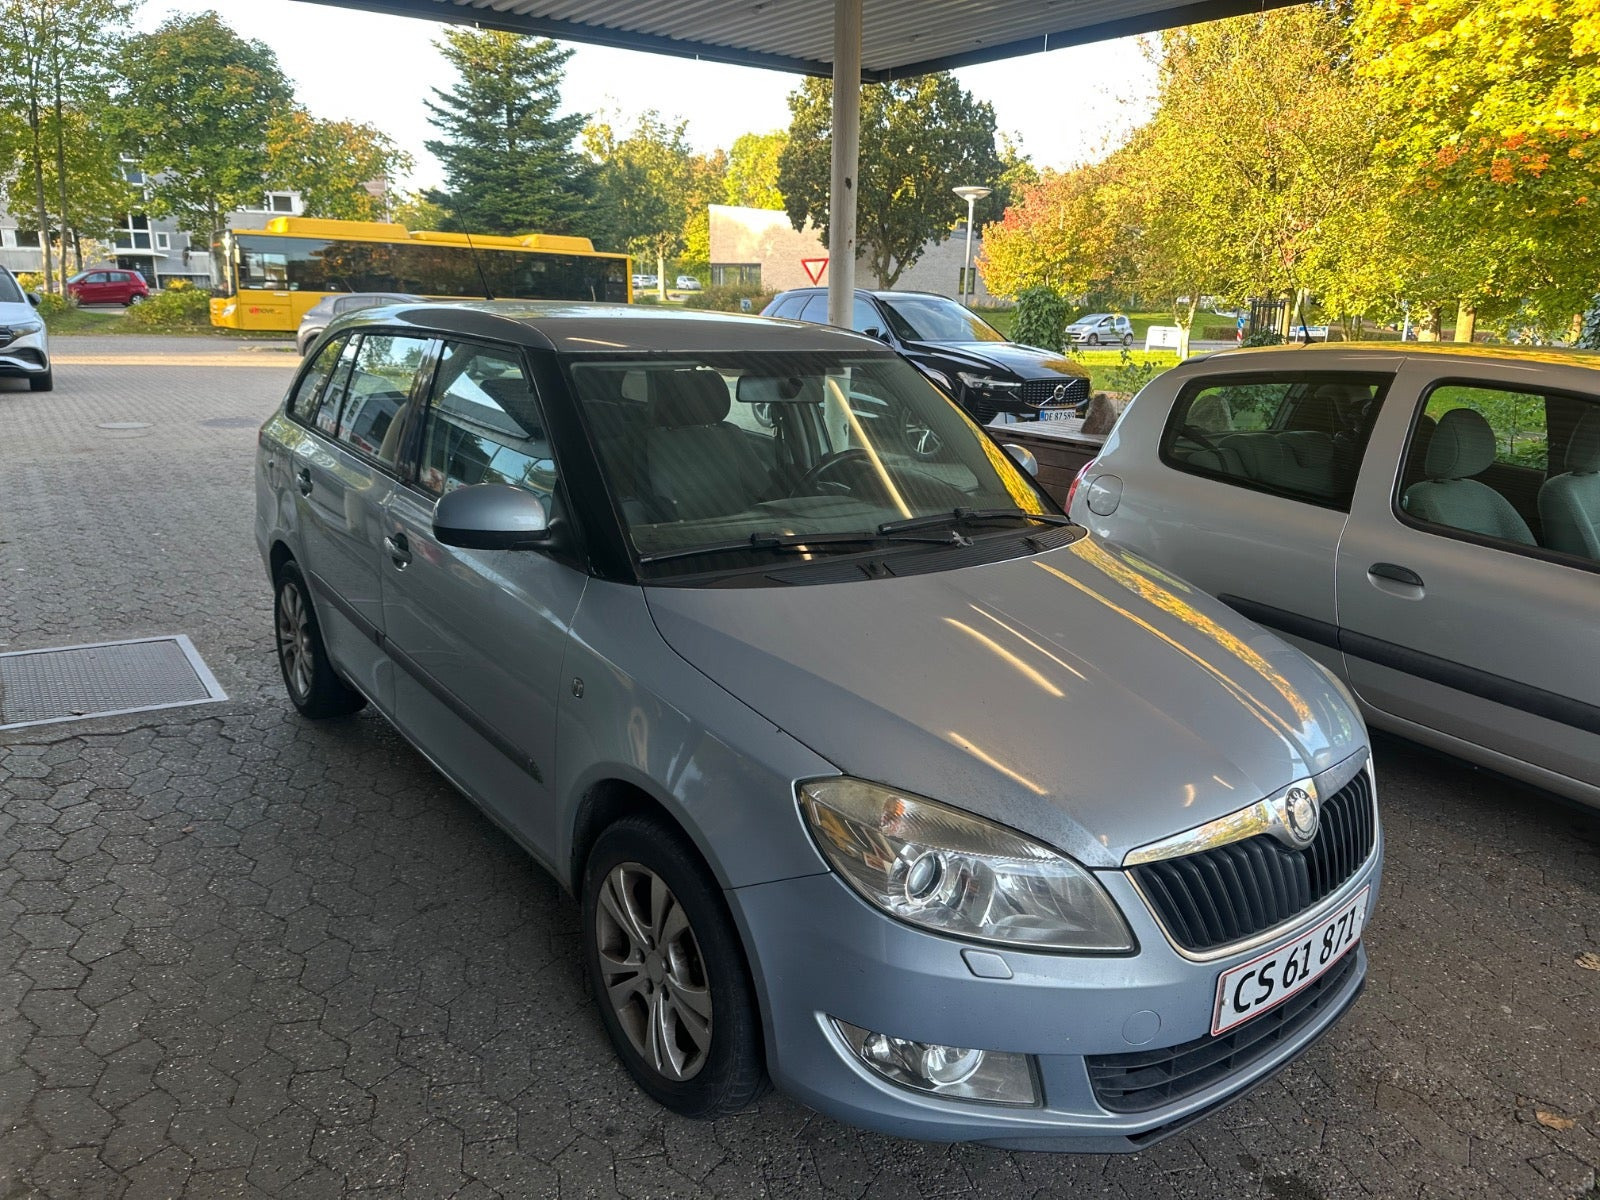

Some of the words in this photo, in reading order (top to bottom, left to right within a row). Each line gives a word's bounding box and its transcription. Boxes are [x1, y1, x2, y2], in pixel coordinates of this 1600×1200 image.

[1233, 960, 1276, 1013] CS
[1282, 940, 1312, 989] 61
[1319, 905, 1357, 965] 871
